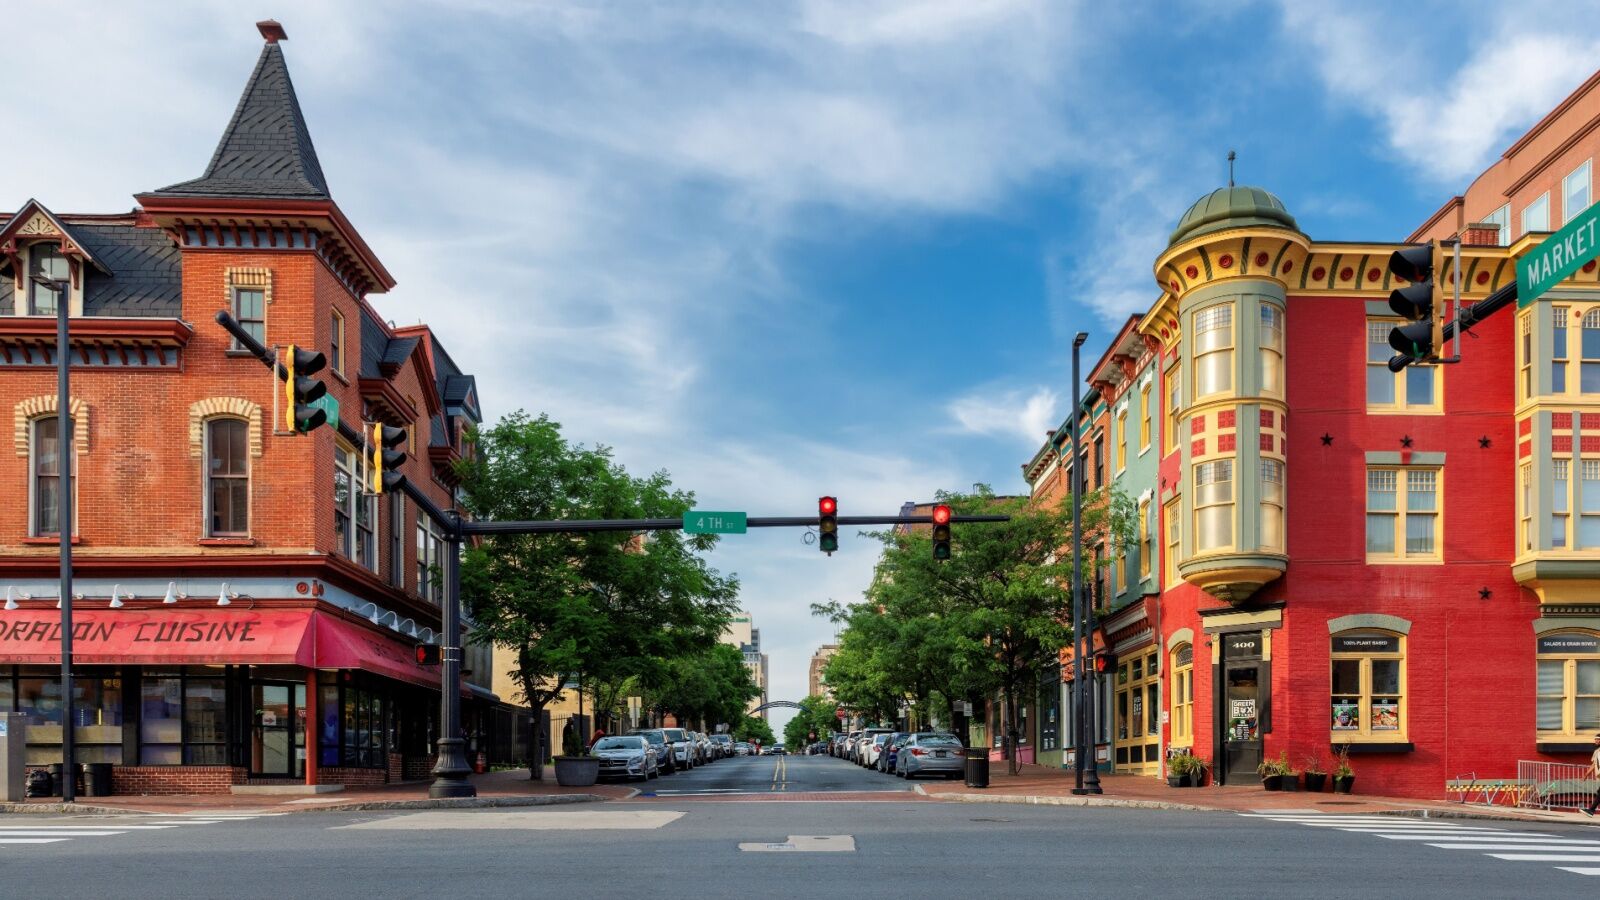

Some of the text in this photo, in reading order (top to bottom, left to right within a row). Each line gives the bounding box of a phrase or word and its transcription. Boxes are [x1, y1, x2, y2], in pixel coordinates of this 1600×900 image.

[1527, 217, 1597, 290] MARKET
[696, 517, 704, 529] 4
[708, 517, 722, 529] TH
[133, 622, 261, 642] CUISINE
